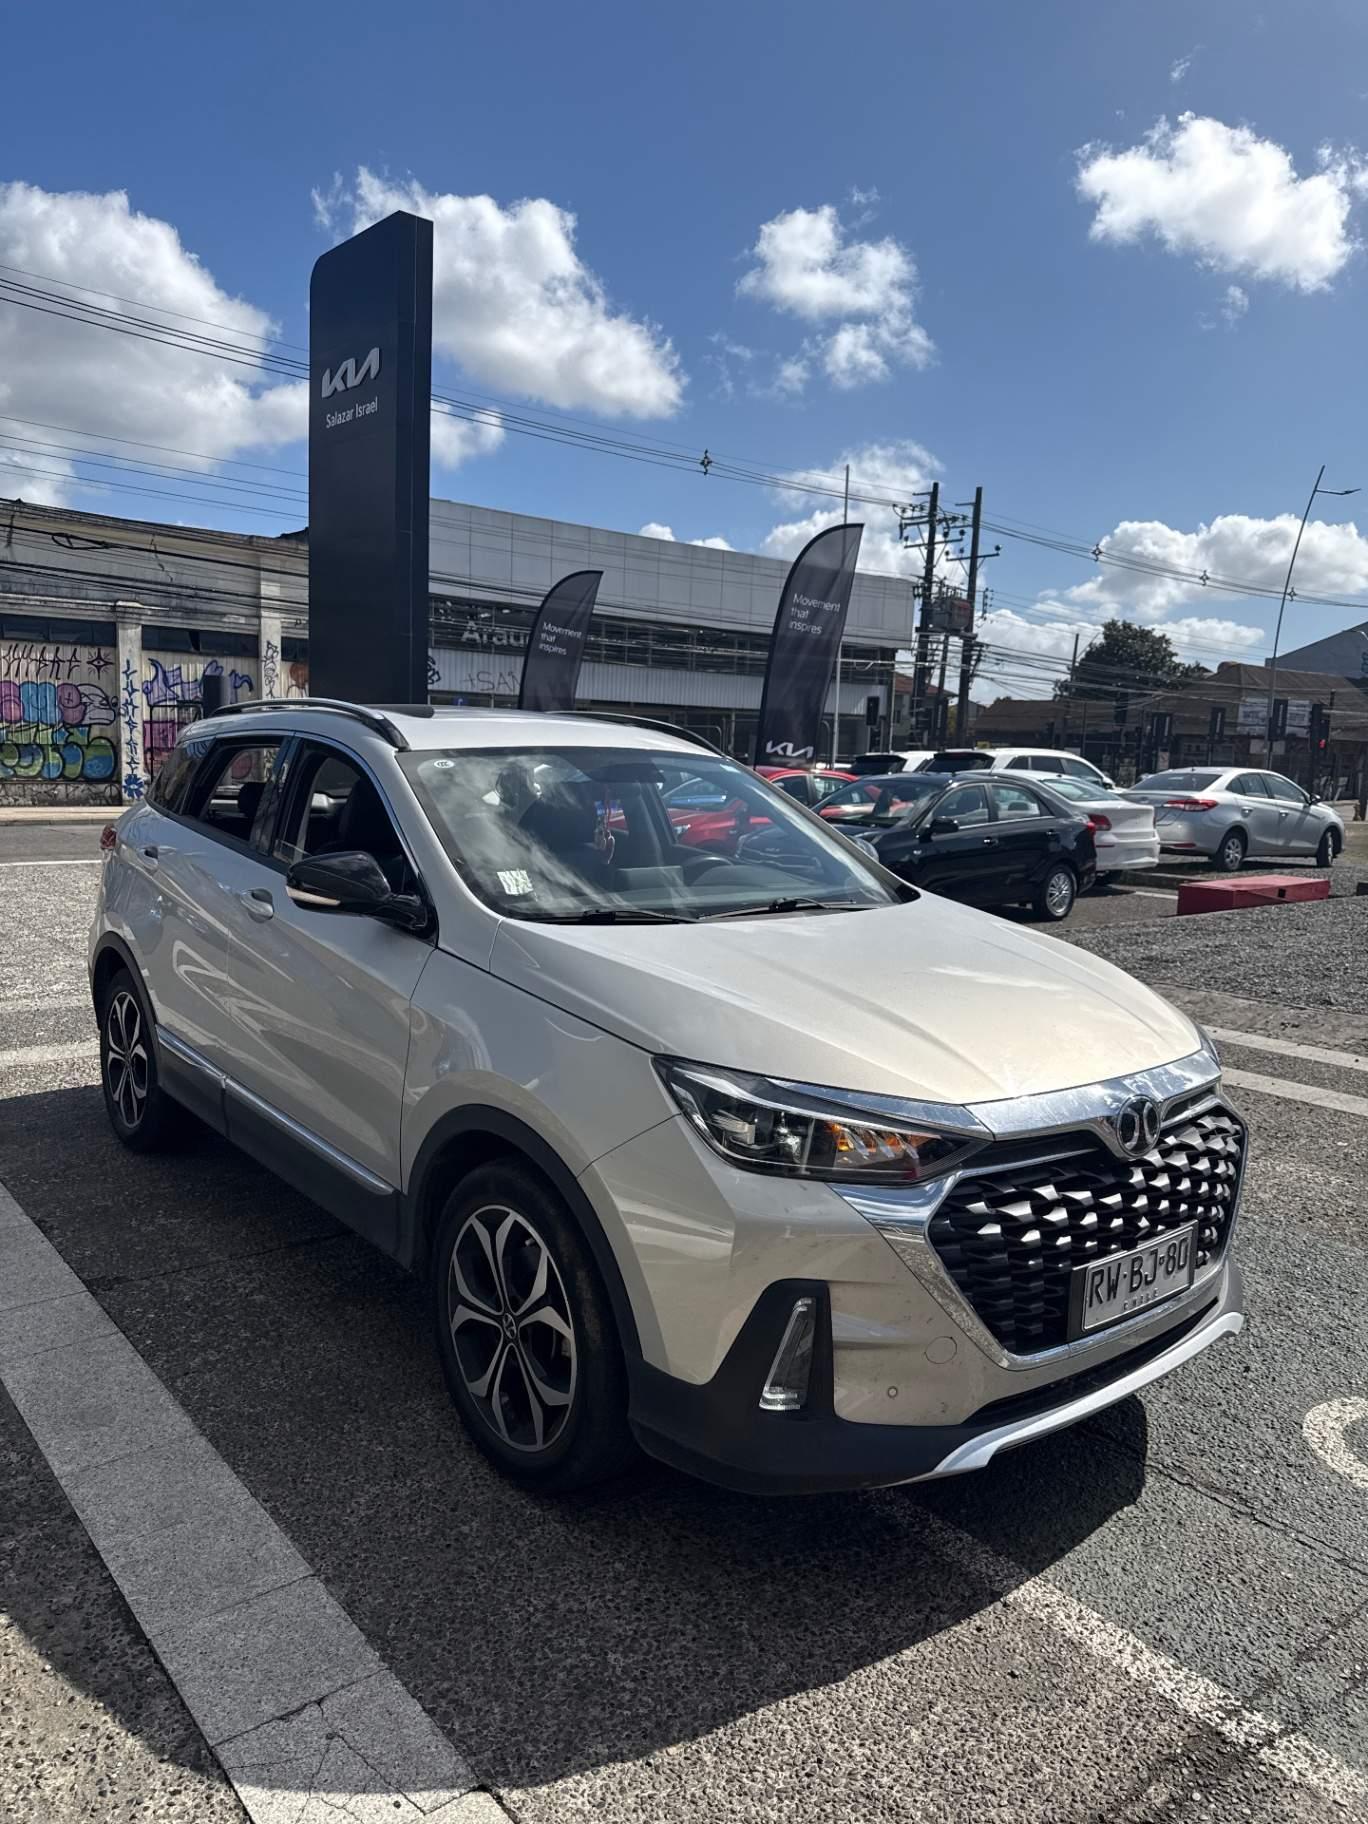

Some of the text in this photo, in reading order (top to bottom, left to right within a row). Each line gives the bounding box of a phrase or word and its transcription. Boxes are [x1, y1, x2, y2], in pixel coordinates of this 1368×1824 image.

[321, 347, 380, 398] KIA
[325, 395, 378, 429] Salazar Israel
[792, 593, 841, 612] Movement
[791, 607, 809, 619] that
[461, 621, 530, 648] Arau
[543, 621, 582, 638] Movement
[789, 620, 822, 634] inspires
[540, 632, 556, 642] that
[539, 643, 567, 655] inspires
[766, 740, 814, 759] KIA
